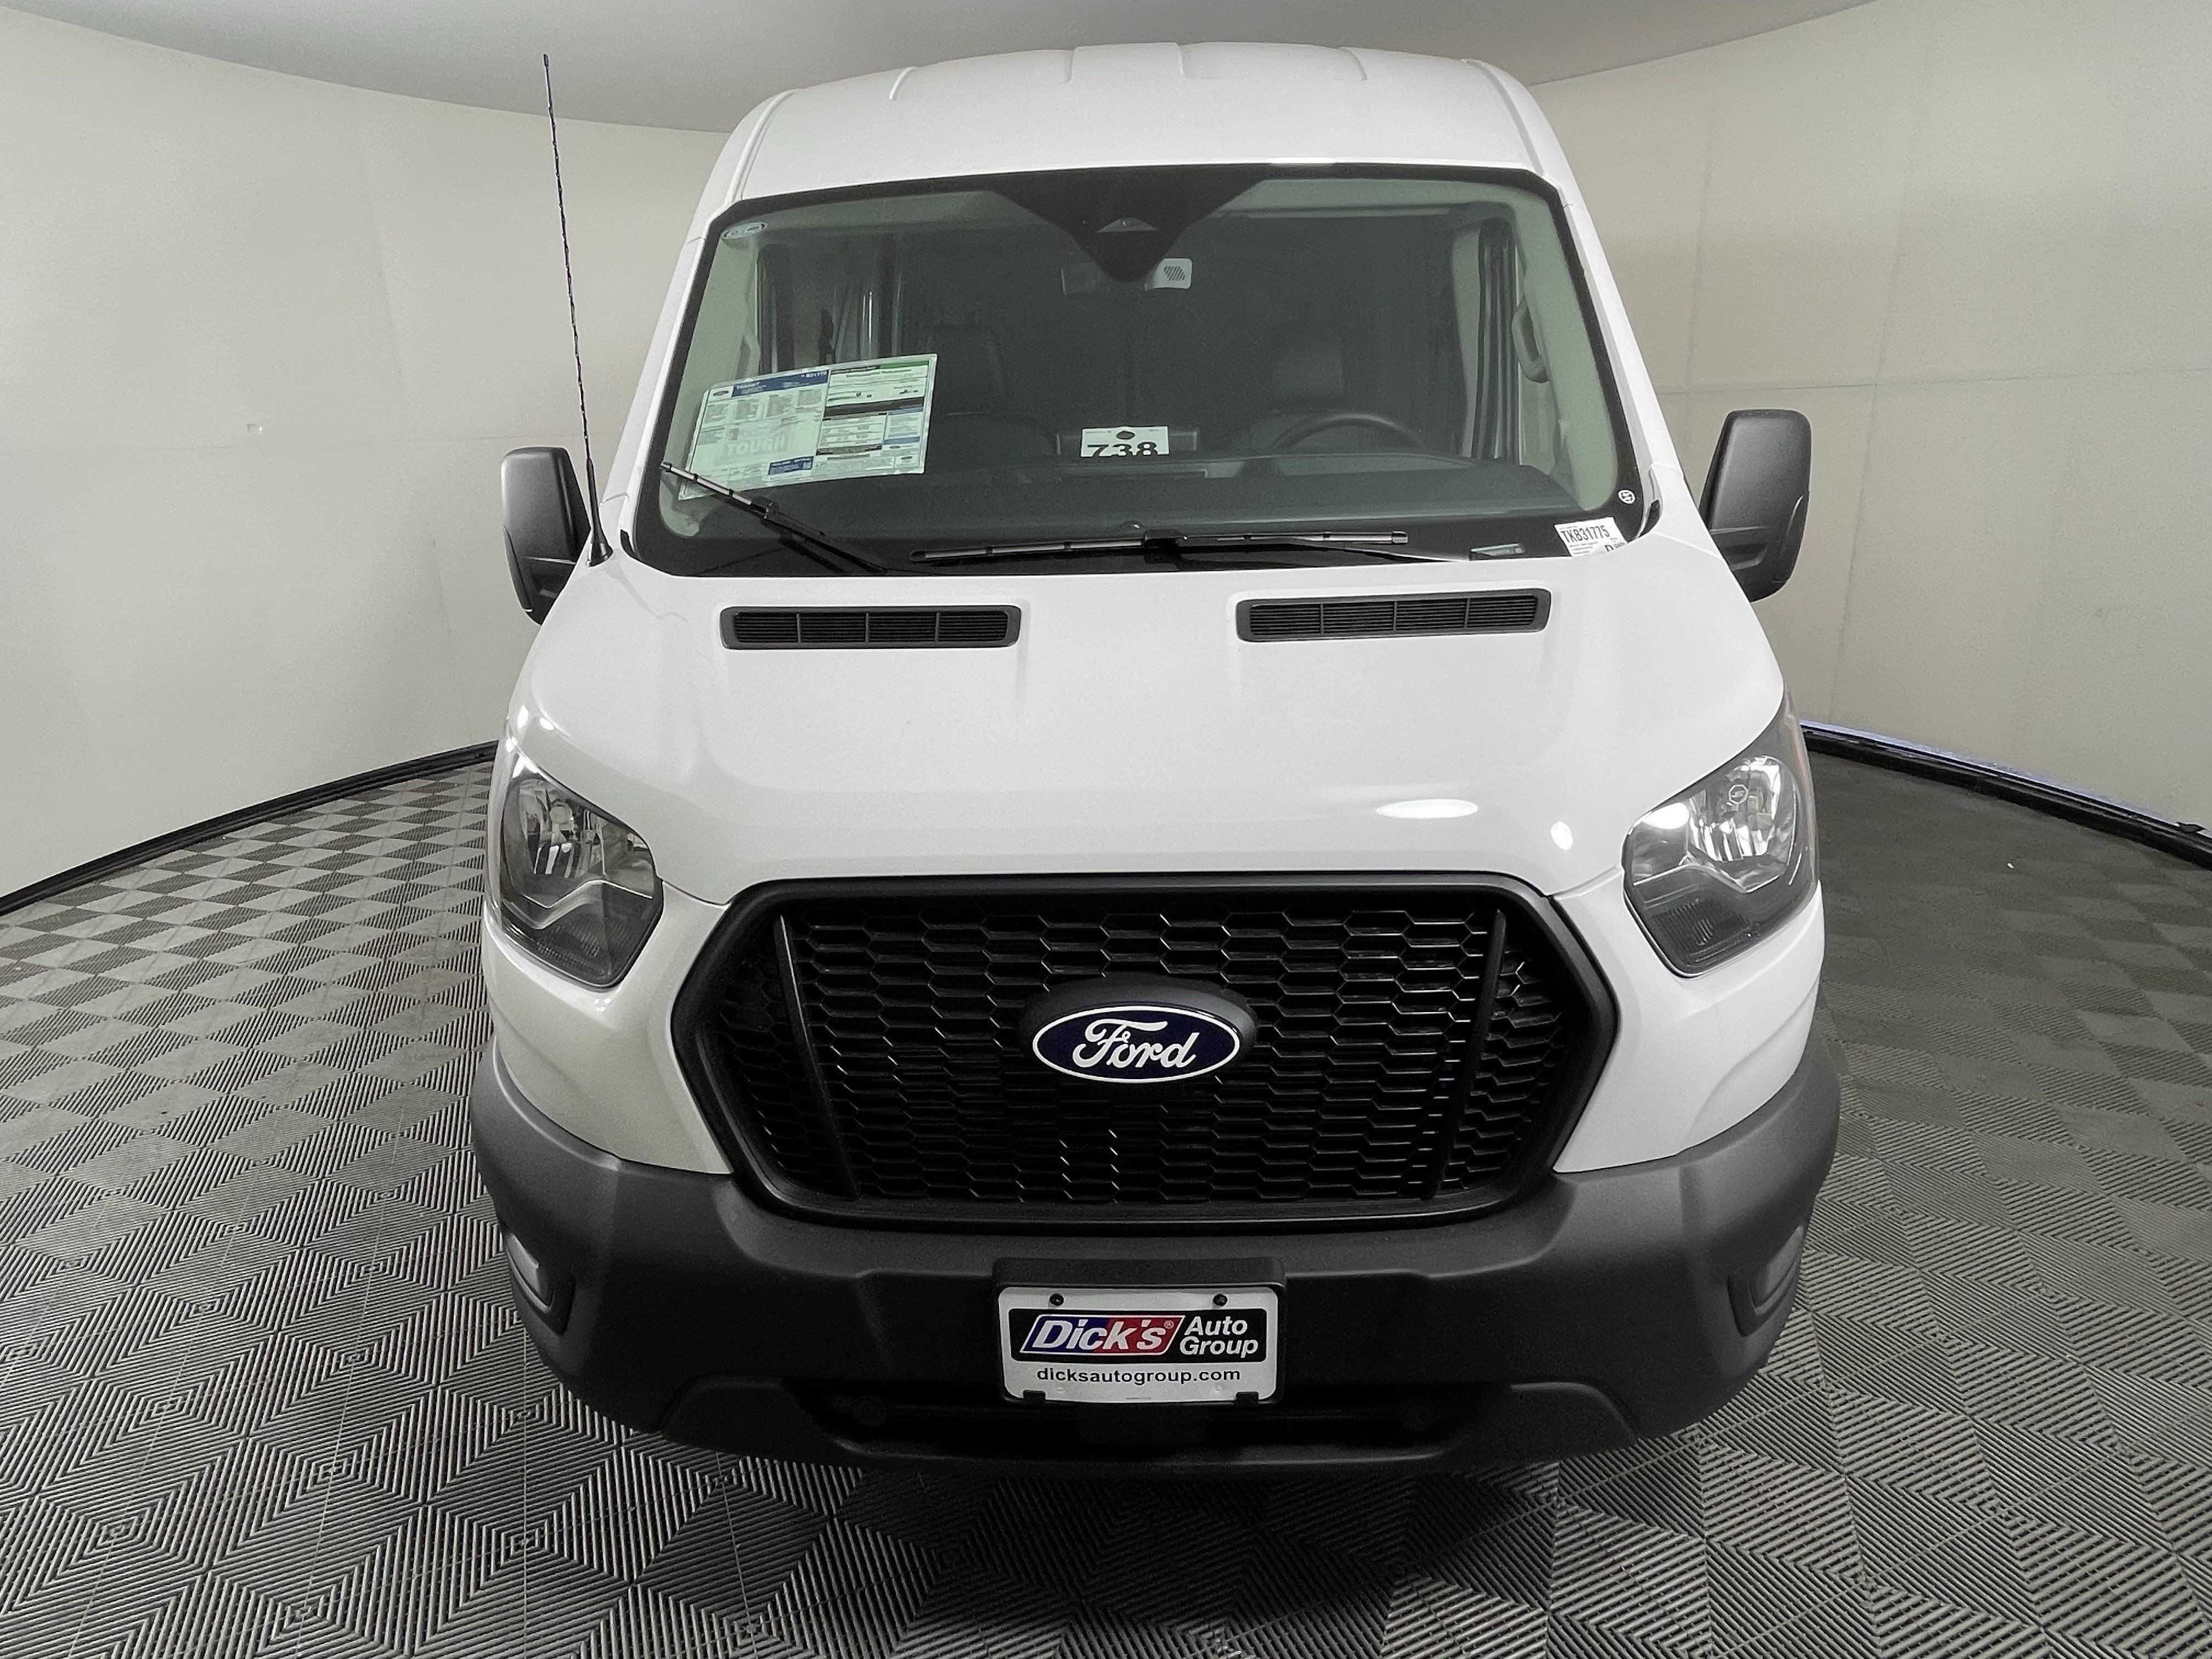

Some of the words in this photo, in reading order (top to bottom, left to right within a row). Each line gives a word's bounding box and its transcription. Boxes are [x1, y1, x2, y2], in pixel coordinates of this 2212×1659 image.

[726, 436, 786, 456] TOUGH
[1087, 441, 1158, 458] 738
[1560, 525, 1610, 543] TKB31775
[1072, 1018, 1200, 1068] Ford
[1031, 1318, 1166, 1351] Dick's
[1184, 1316, 1248, 1336] Auto
[1180, 1335, 1259, 1358] Group
[1037, 1367, 1241, 1386] dicksautogroup.com
